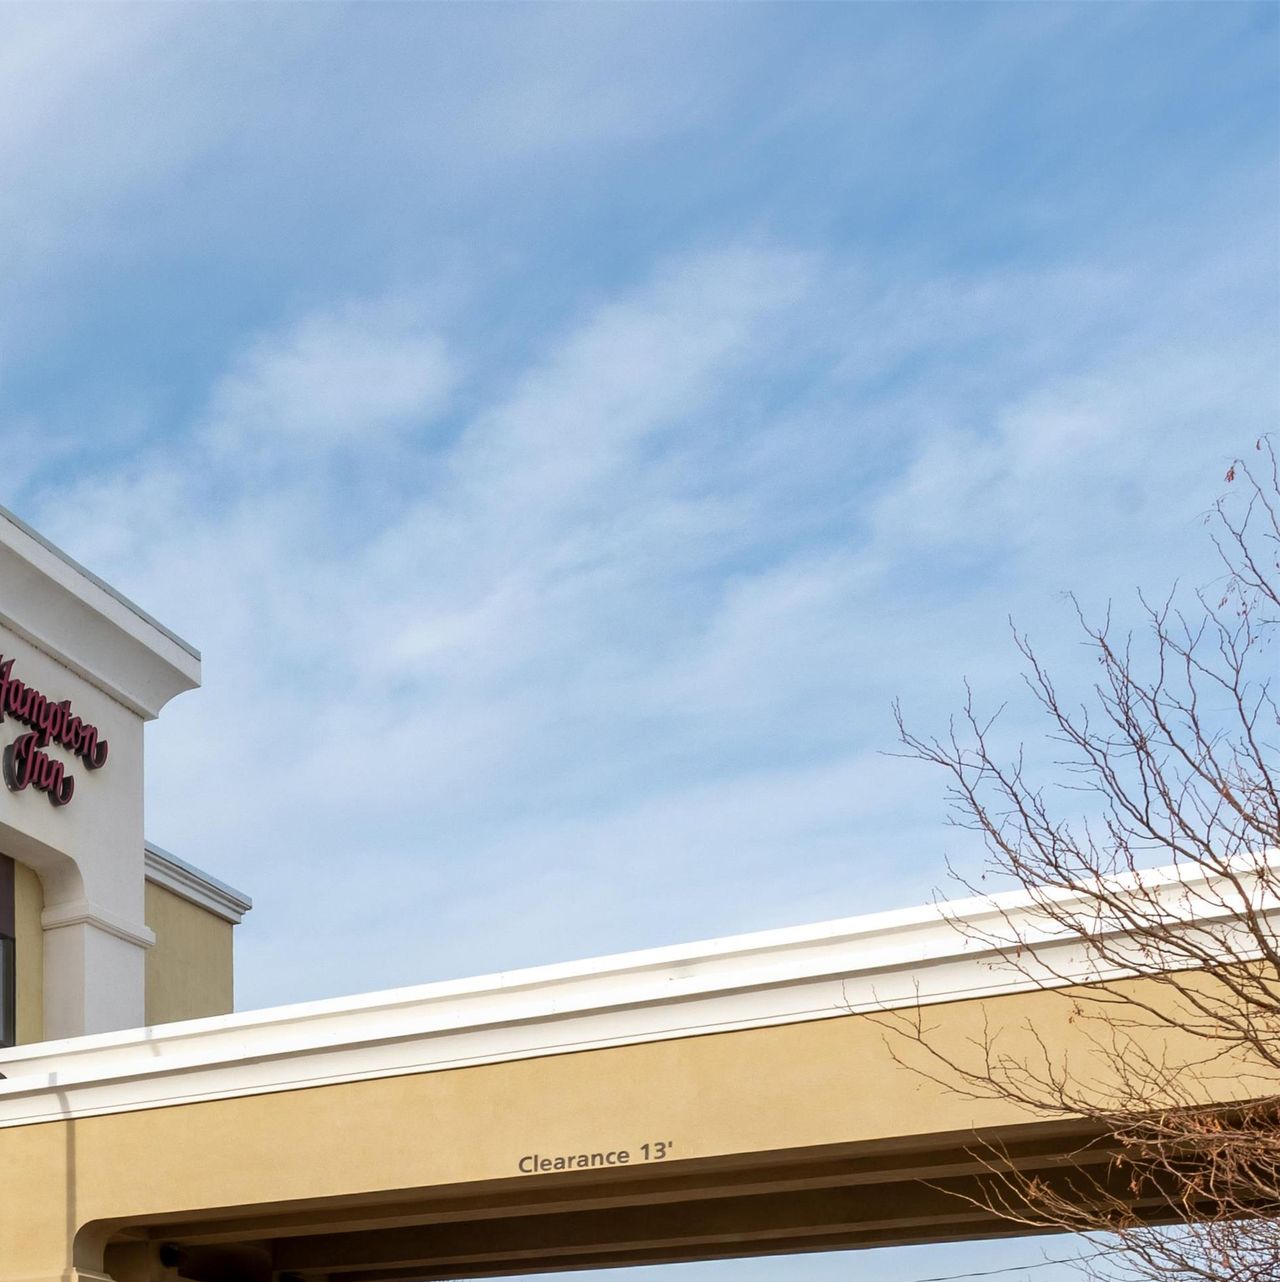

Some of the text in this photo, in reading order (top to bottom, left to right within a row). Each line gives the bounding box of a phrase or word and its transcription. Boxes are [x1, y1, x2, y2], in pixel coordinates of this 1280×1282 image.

[3, 732, 75, 807] Inn
[518, 1141, 673, 1173] Clearance 13'
